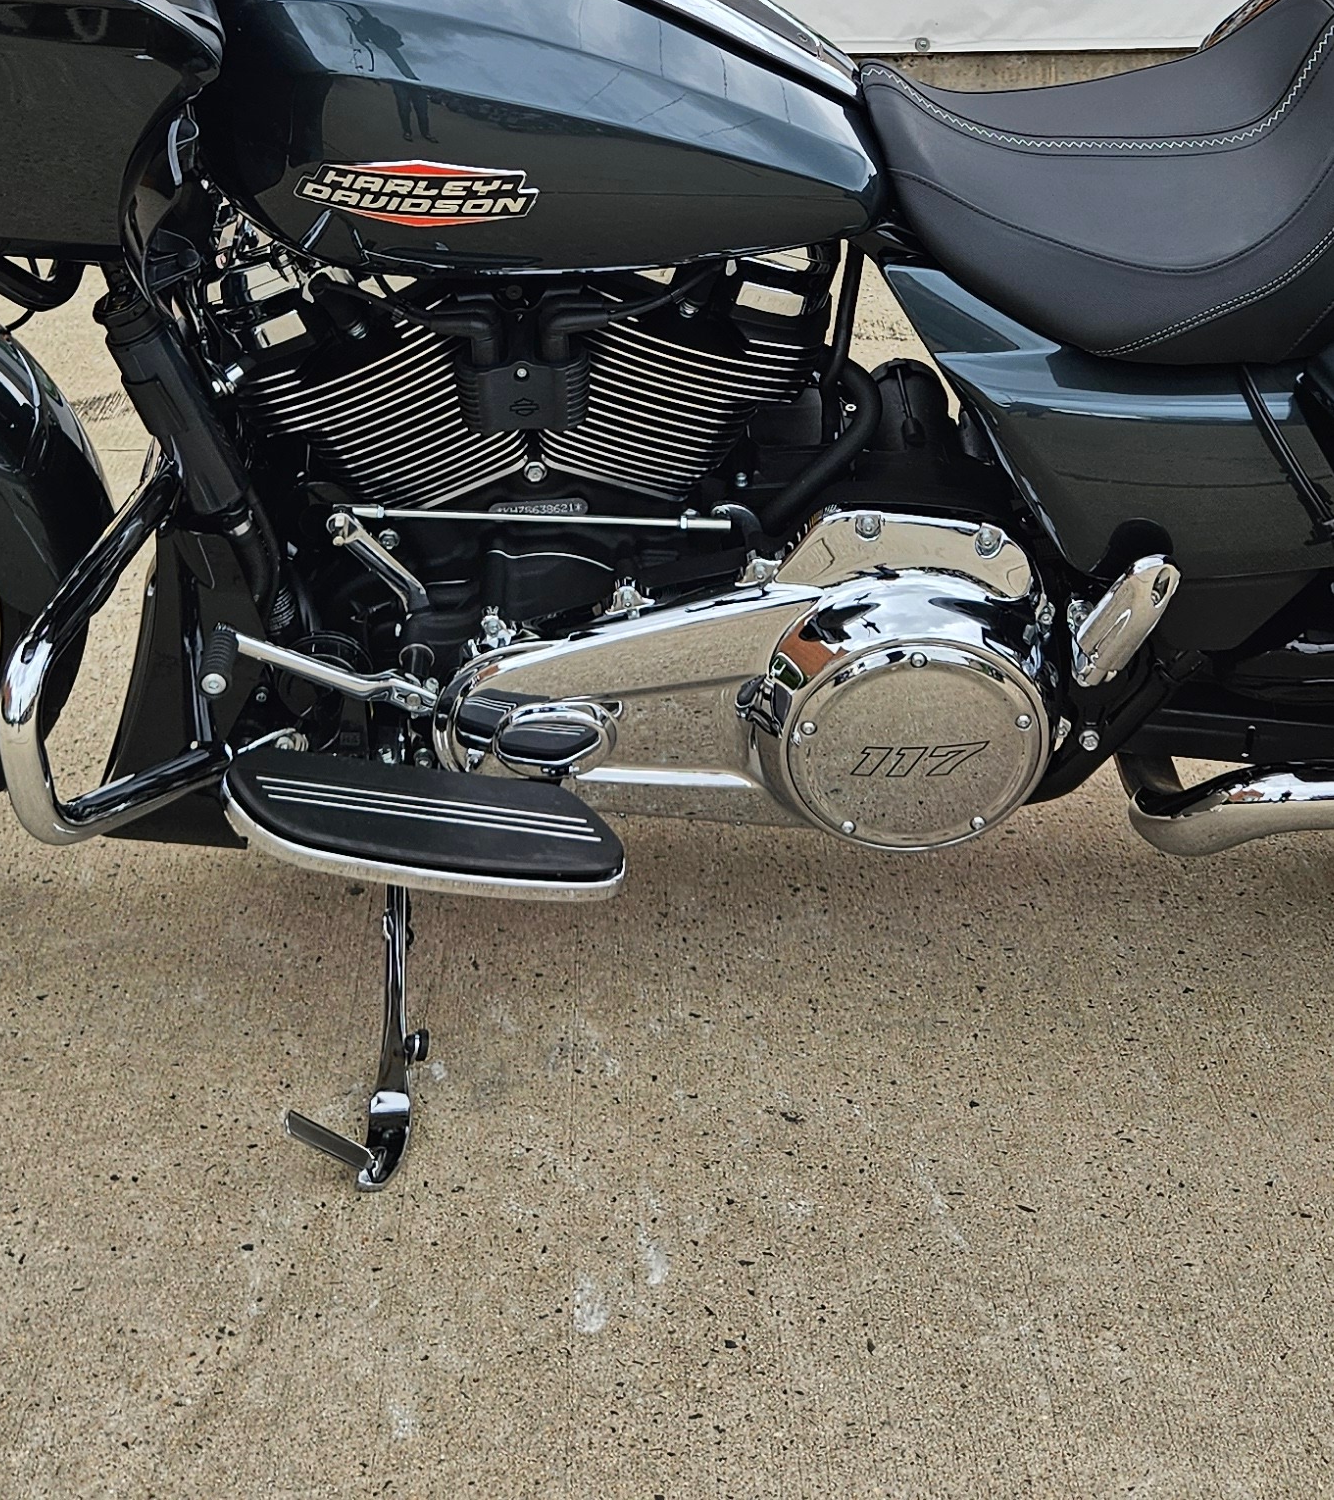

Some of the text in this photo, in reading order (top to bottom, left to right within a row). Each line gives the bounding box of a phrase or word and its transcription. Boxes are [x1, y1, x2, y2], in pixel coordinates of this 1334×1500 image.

[302, 182, 527, 214] DAVIDSON
[322, 170, 515, 196] HARLEY-
[850, 740, 990, 777] 117
